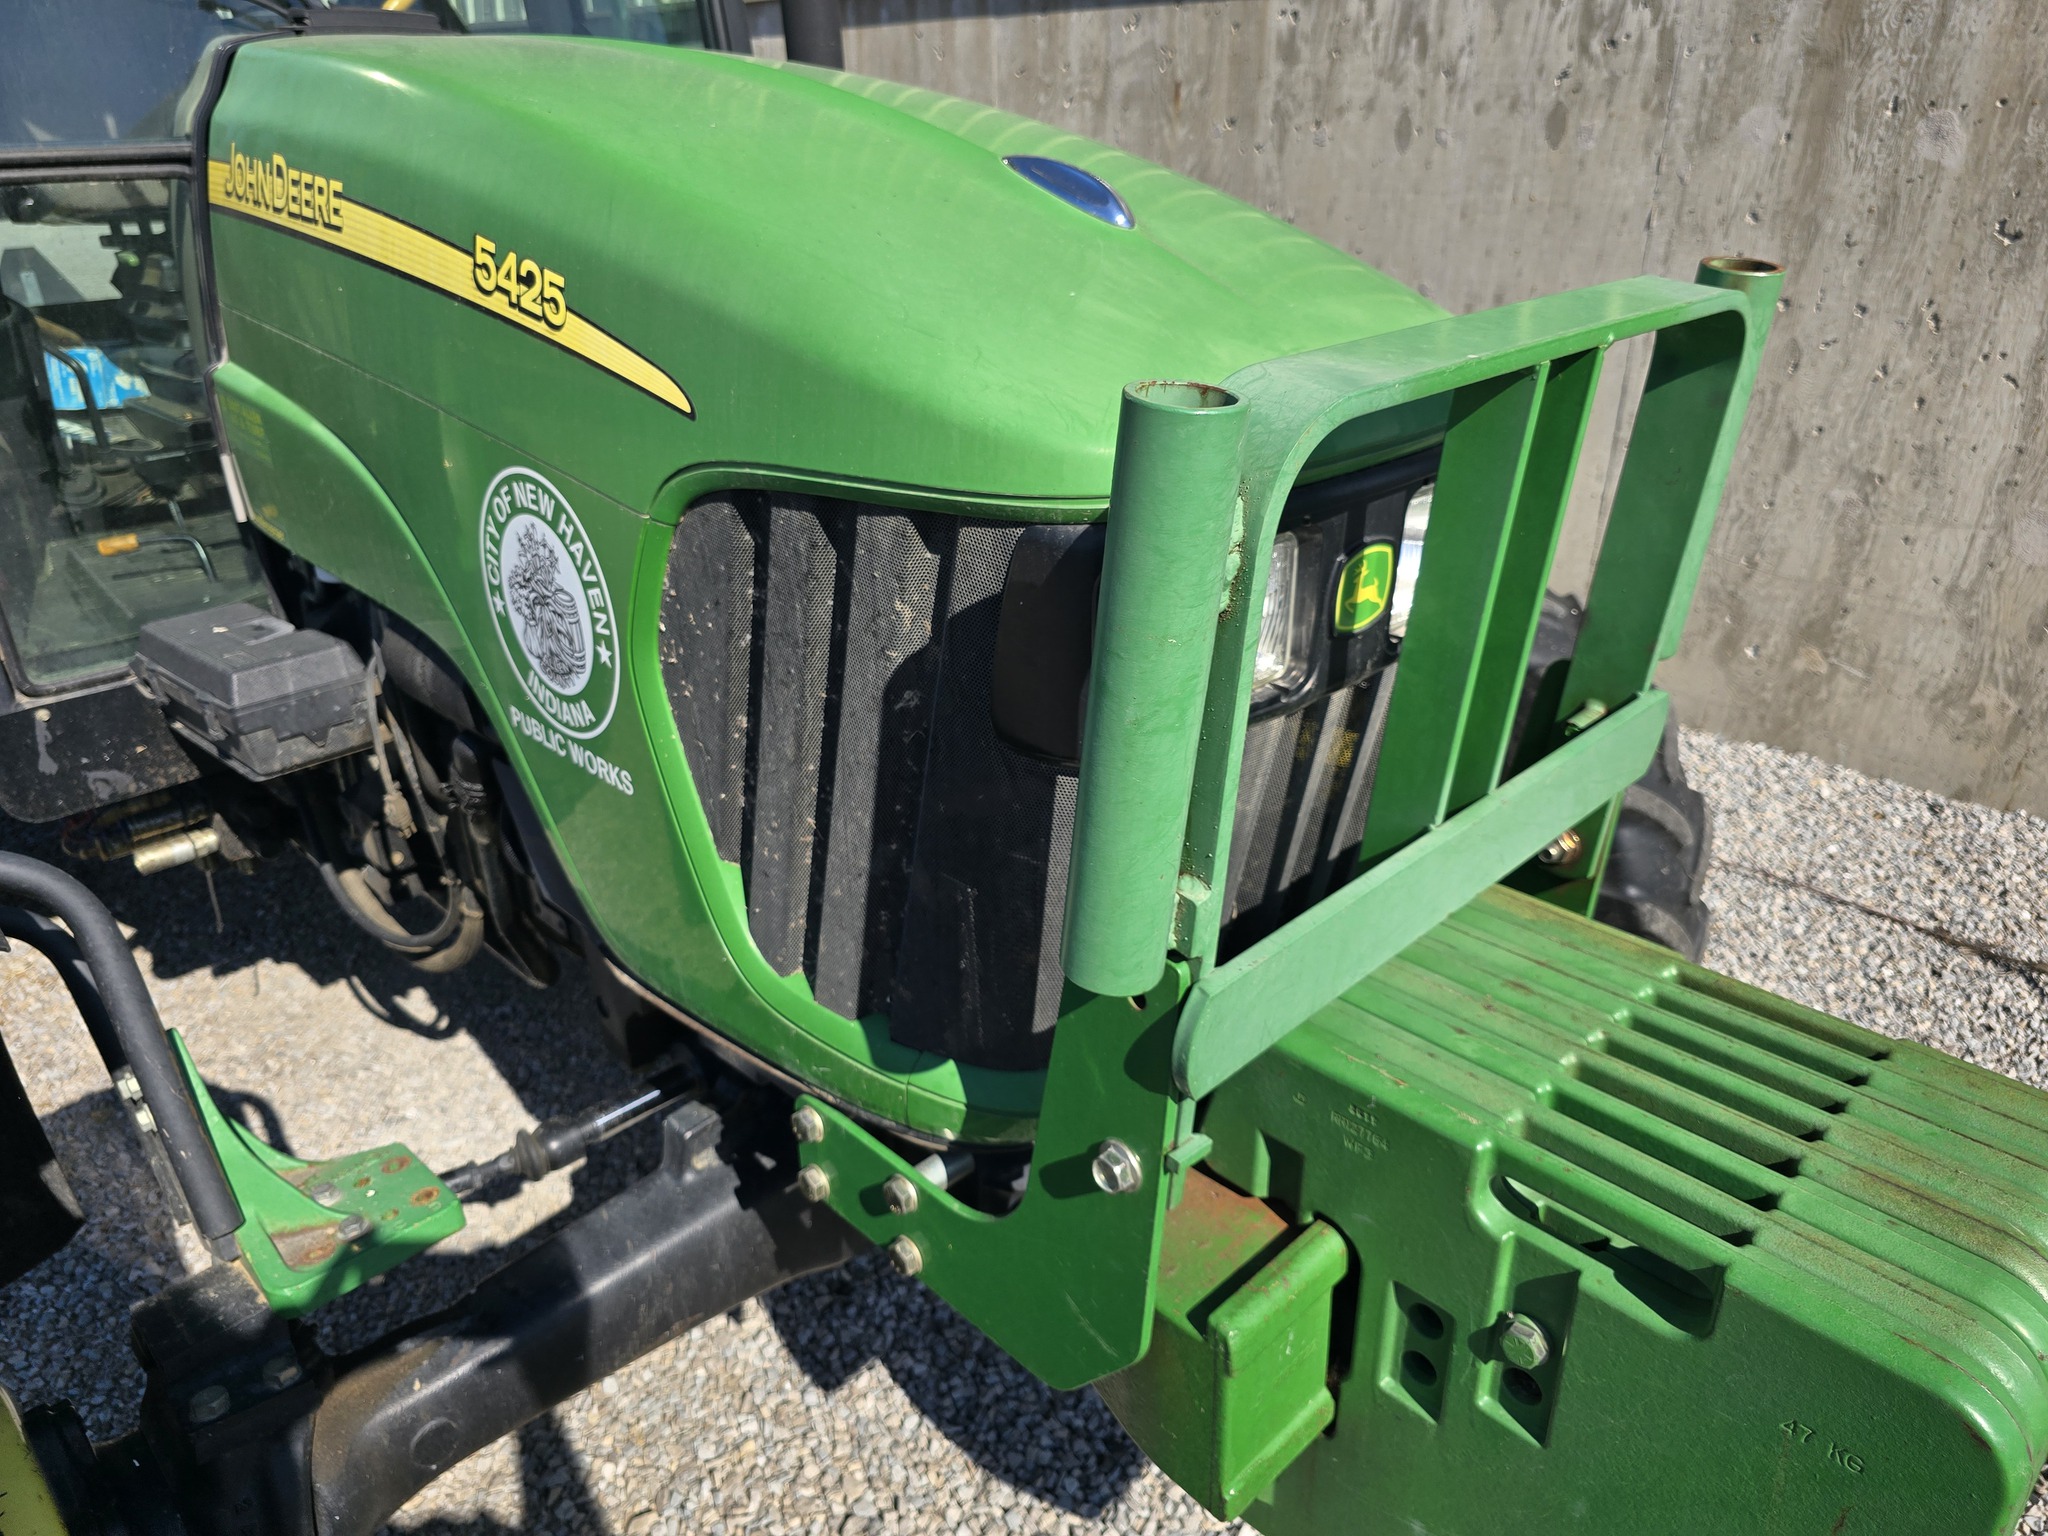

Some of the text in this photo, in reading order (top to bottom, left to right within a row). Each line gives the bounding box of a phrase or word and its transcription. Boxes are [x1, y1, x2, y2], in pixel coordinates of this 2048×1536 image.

[224, 142, 345, 232] JOHN DEERE
[473, 233, 568, 330] 5425
[485, 480, 611, 637] CITY OF NEW HAVEN
[527, 669, 596, 728] INDIANA
[510, 703, 636, 796] PUBLIC WORKS
[1778, 1419, 1865, 1476] 47 KG
